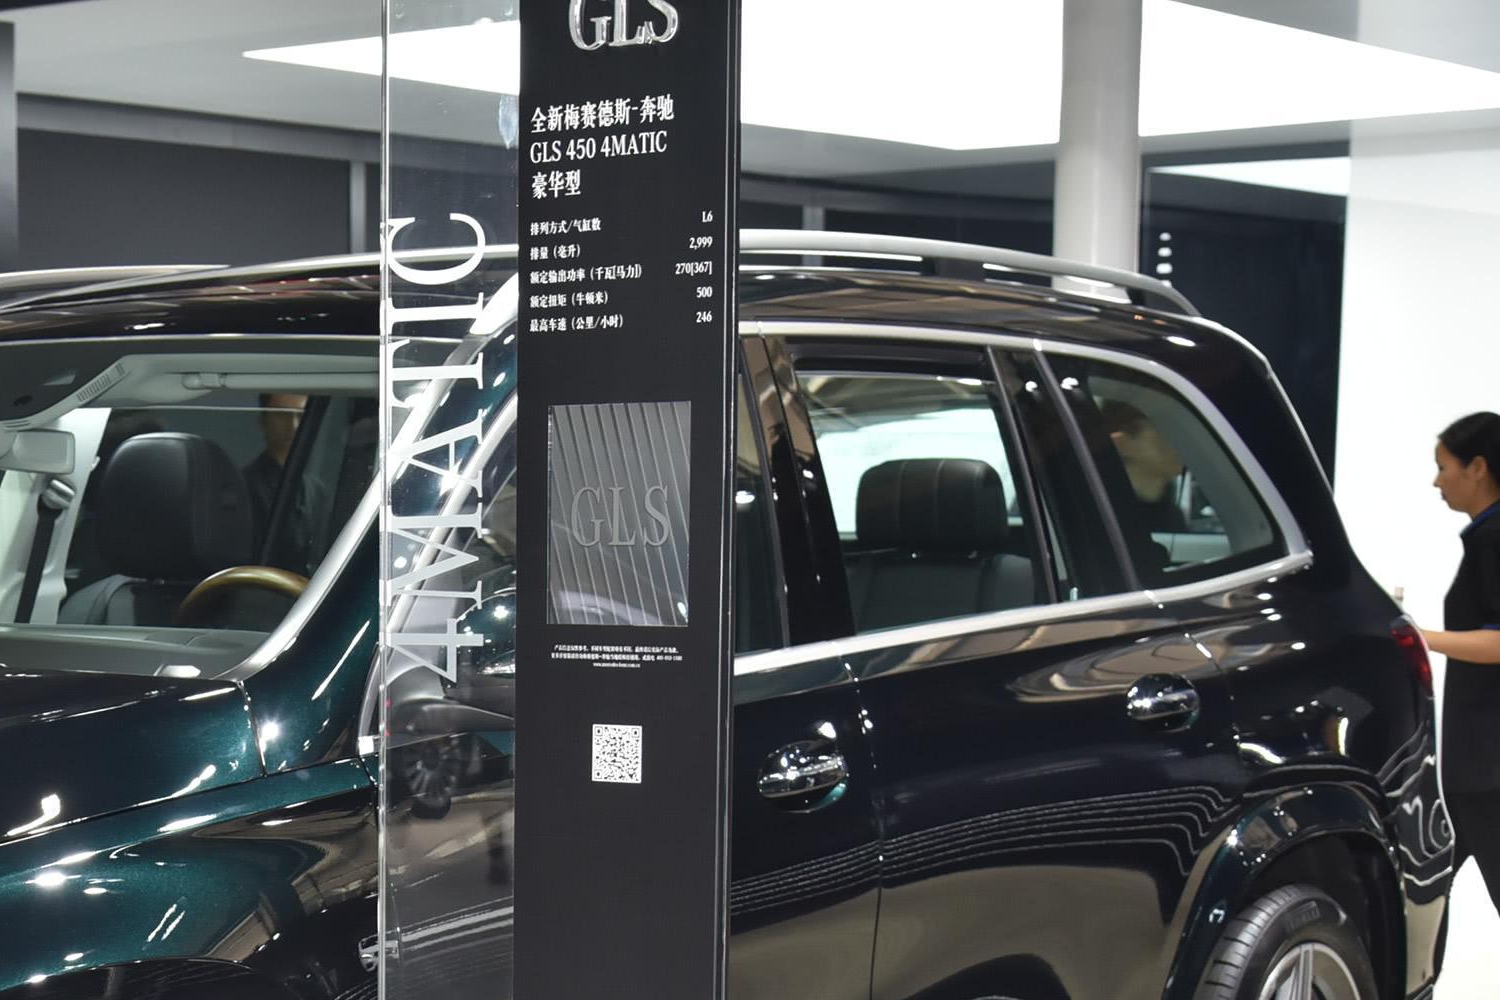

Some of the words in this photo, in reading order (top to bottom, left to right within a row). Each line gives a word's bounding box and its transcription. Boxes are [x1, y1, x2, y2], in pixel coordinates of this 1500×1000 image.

[569, 0, 678, 50] GLS
[531, 94, 675, 133] 全新梅赛德斯-奔驰
[530, 140, 561, 163] GLS
[566, 137, 596, 160] 450
[600, 130, 667, 157] 4MATIC
[531, 169, 581, 199] 豪华型
[702, 210, 713, 222] L6
[689, 236, 713, 250] 2,999
[675, 261, 713, 276] 270[367]
[696, 286, 713, 298] 500
[696, 311, 713, 323] 246
[383, 212, 486, 683] 4MATIC
[570, 486, 669, 547] GLS
